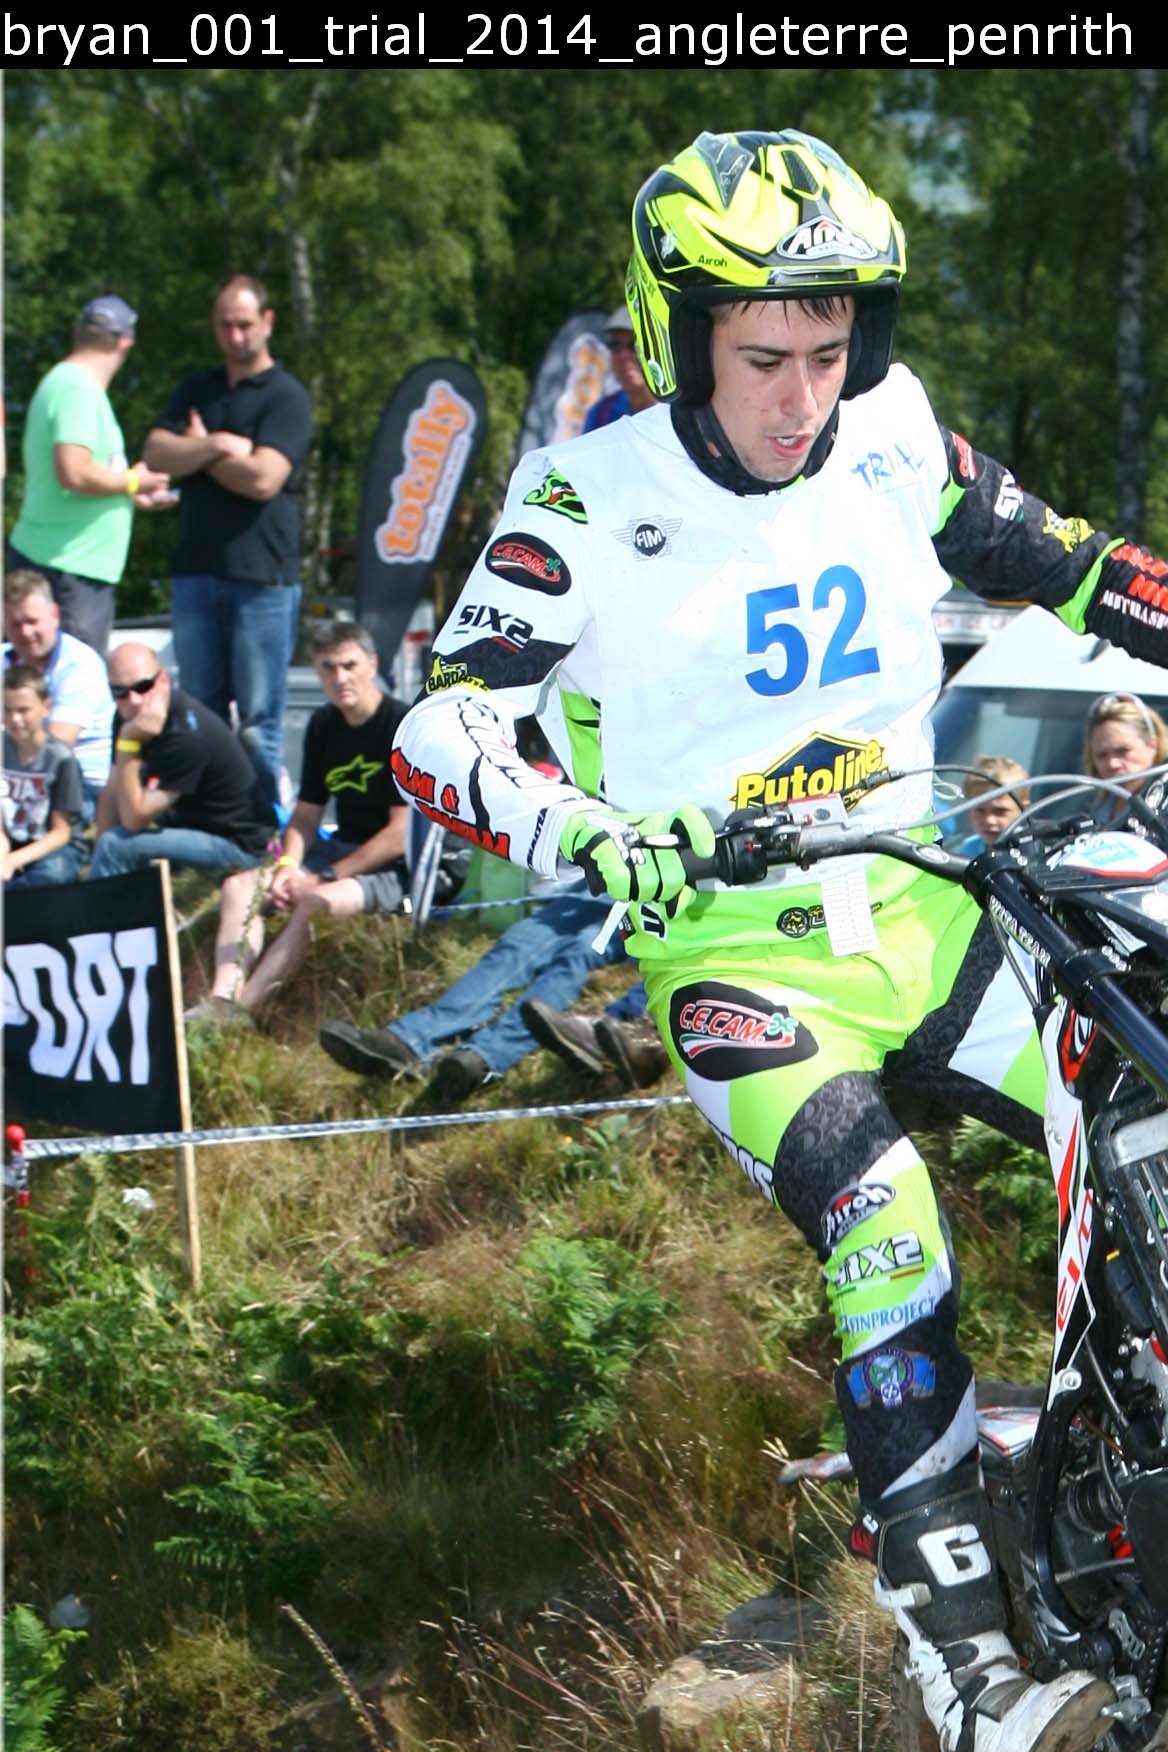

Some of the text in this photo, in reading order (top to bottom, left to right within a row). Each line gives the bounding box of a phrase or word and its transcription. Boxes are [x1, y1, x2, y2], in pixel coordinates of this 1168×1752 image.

[384, 387, 467, 555] totally
[636, 529, 664, 549] FIM
[457, 604, 535, 649] SIX2
[745, 565, 880, 697] 52
[735, 739, 884, 809] Putoline
[917, 1523, 992, 1588] G
